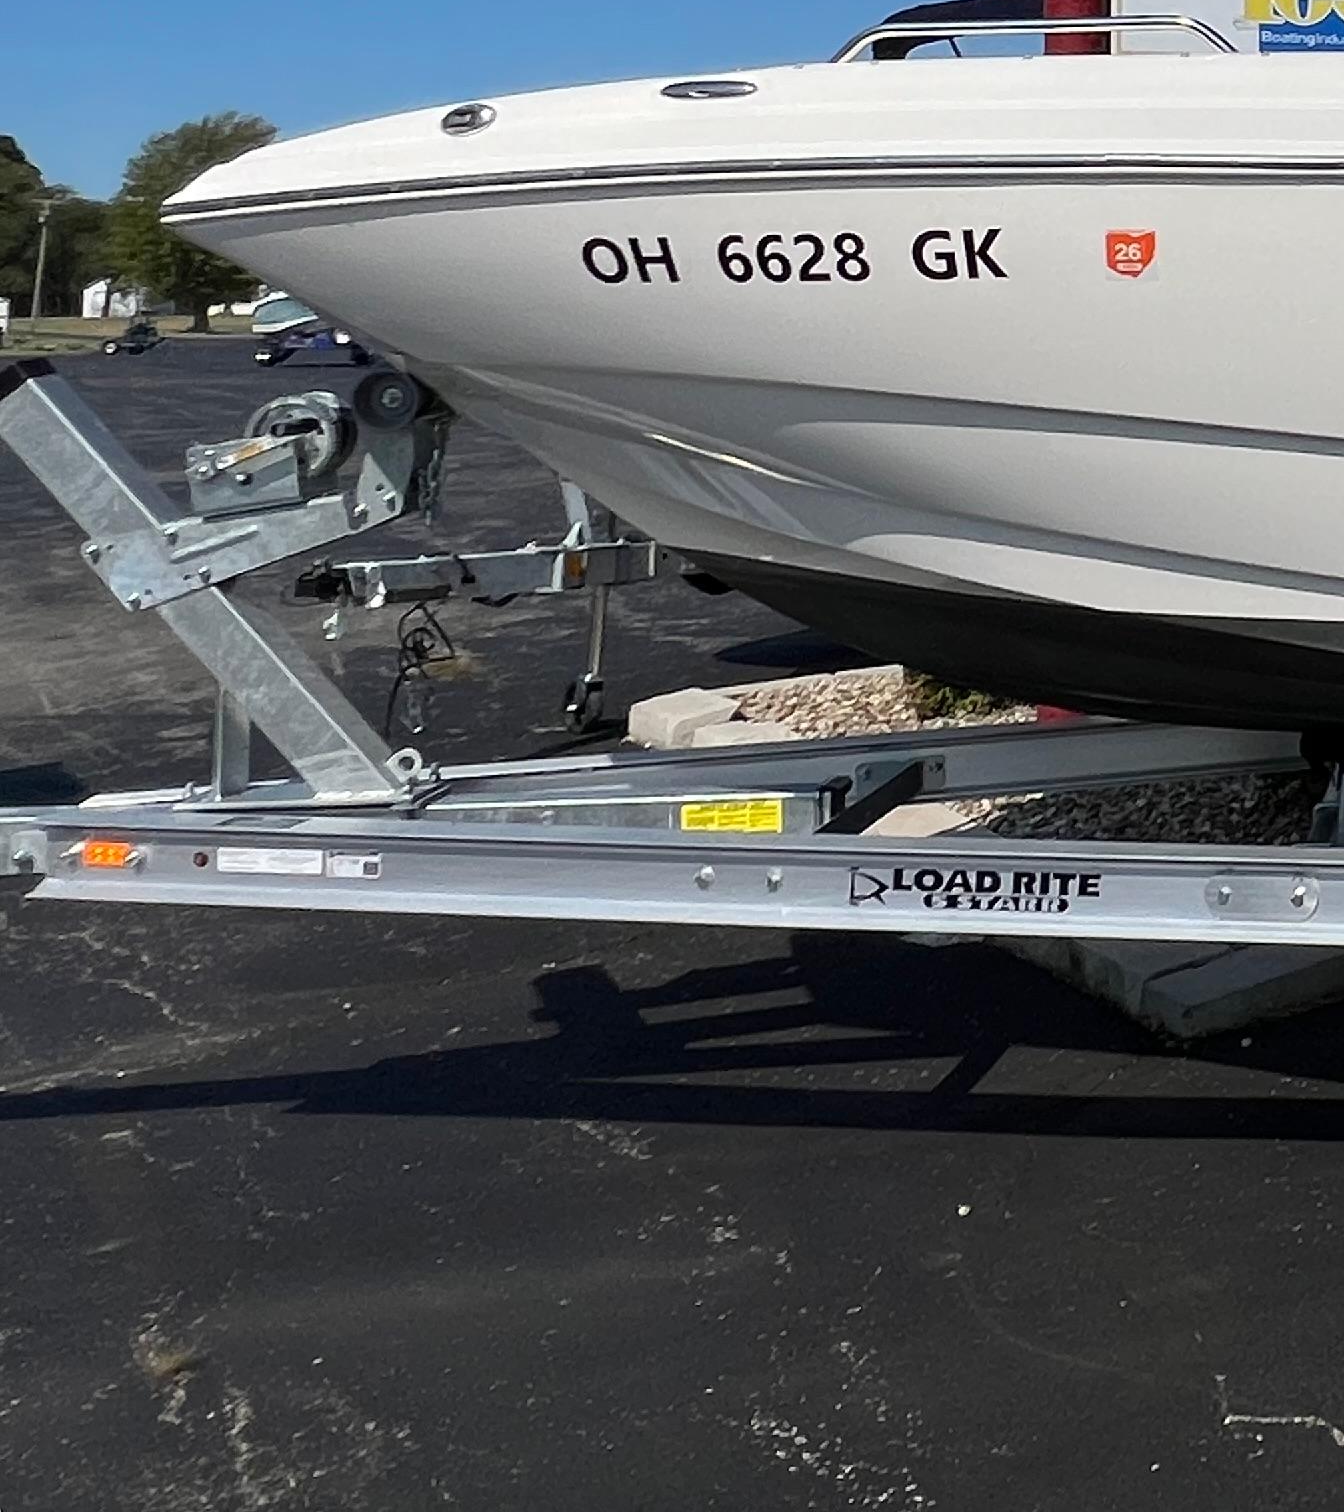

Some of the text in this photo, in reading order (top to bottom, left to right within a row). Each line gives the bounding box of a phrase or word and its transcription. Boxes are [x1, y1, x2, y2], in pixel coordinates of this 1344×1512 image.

[581, 228, 1009, 285] OH 6628 GK
[1113, 242, 1143, 261] 26
[891, 867, 1102, 898] LOAD RITE
